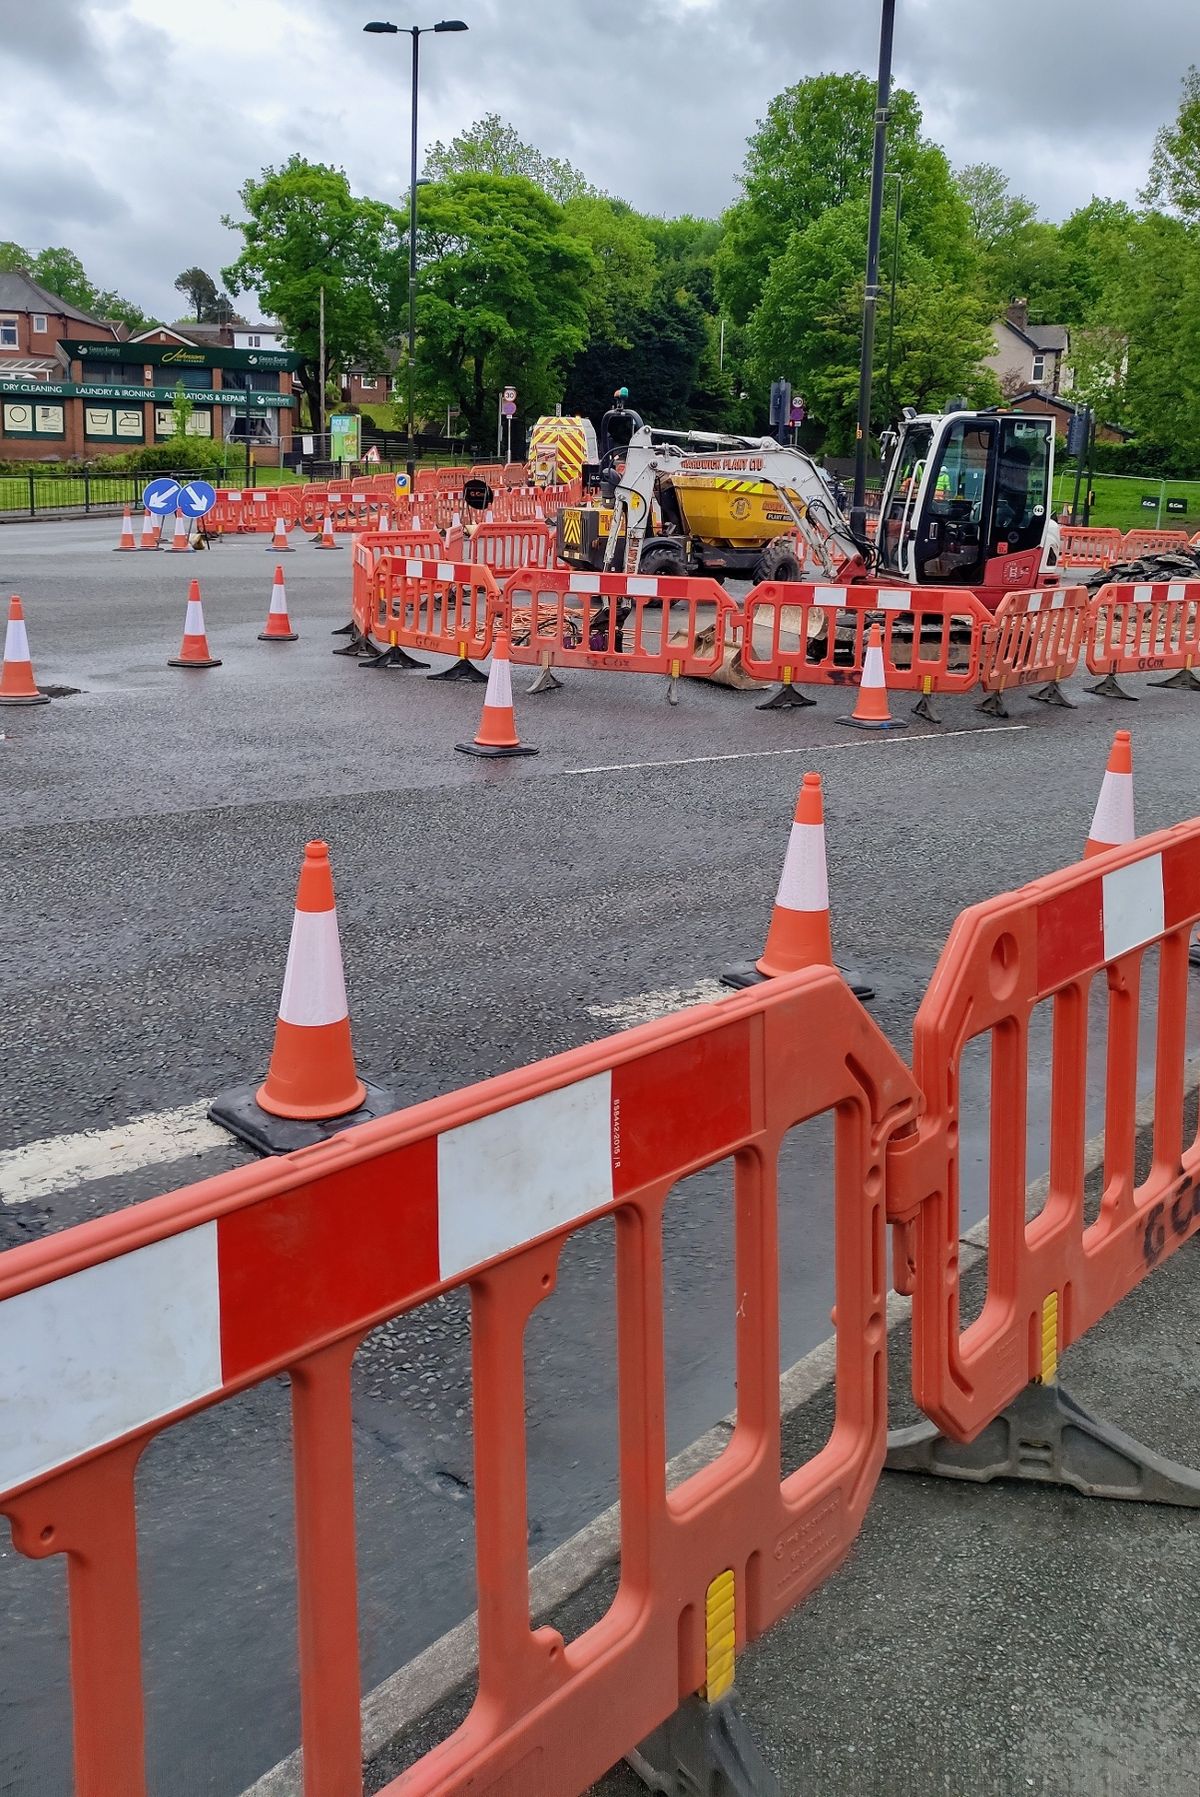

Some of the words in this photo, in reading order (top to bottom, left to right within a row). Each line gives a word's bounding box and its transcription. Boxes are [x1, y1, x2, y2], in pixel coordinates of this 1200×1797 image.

[3, 383, 19, 391] DRY
[20, 384, 63, 393] CLEANING
[75, 387, 112, 396] LAUNDRY
[121, 389, 156, 398] IRONING
[164, 391, 214, 400] ALTRATIONS
[222, 394, 247, 402] REPAIR
[722, 459, 748, 470] PLANT
[749, 458, 764, 471] LTD
[1138, 657, 1146, 670] G
